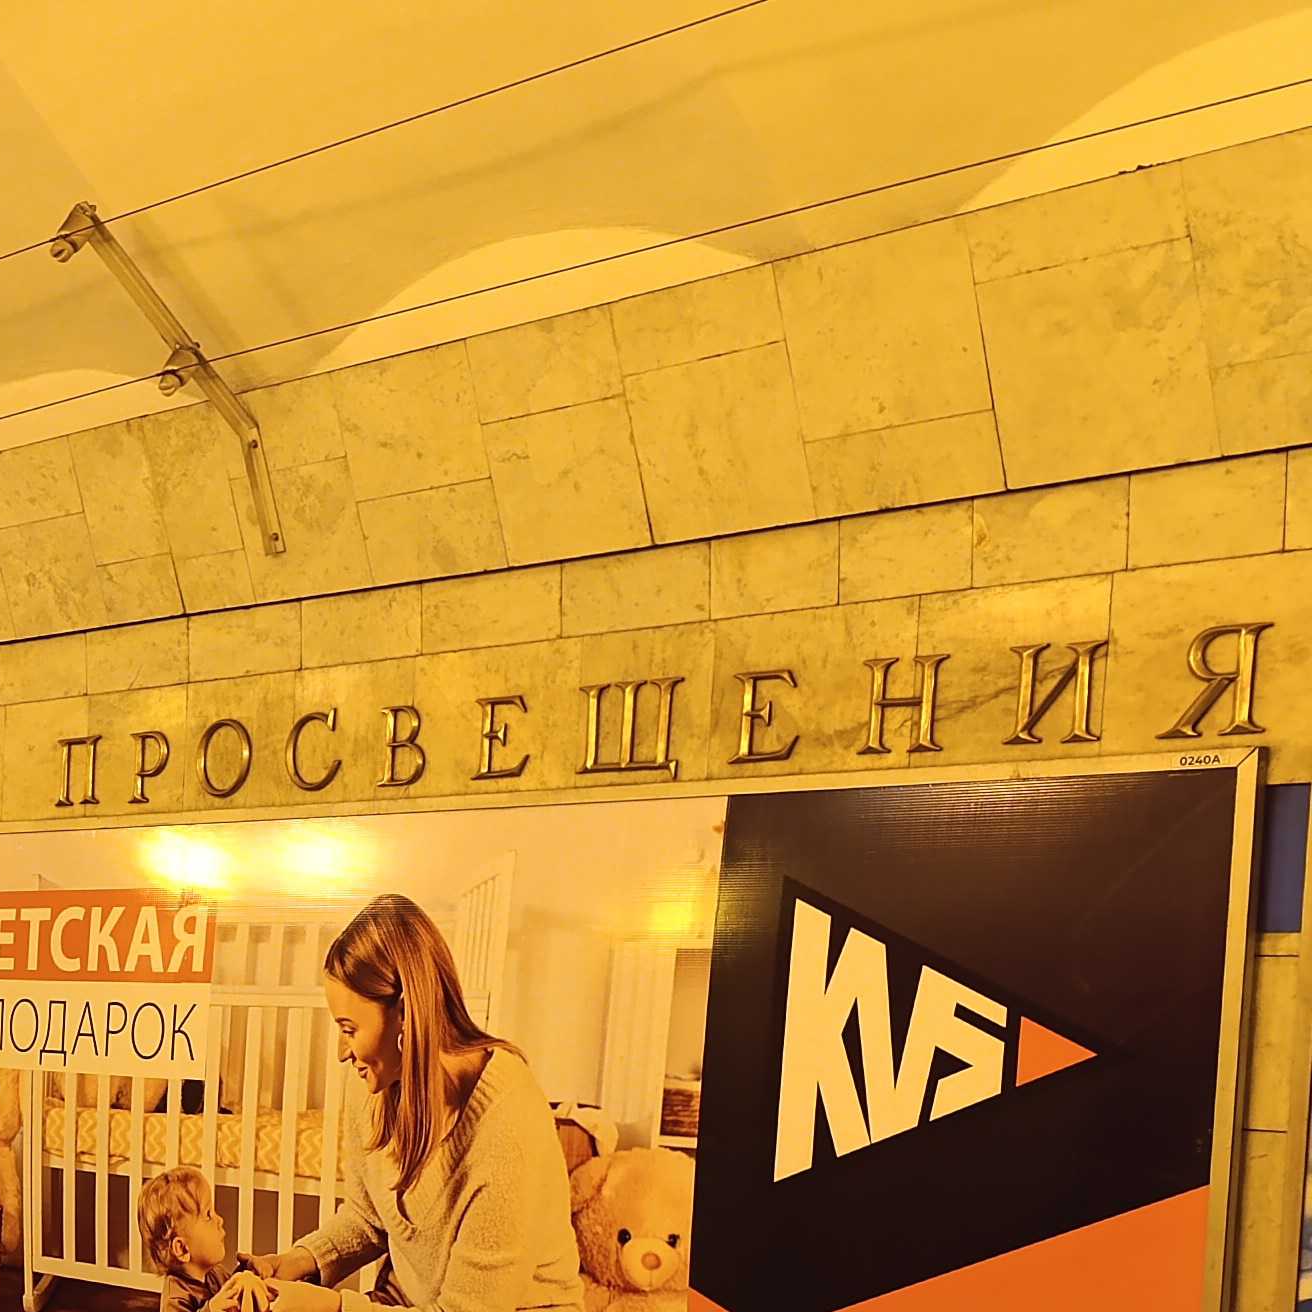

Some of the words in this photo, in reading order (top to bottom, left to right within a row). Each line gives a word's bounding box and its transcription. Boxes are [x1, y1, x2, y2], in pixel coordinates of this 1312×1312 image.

[56, 621, 1277, 807] ПРОСВЕЩЕНИЯ
[1179, 754, 1221, 766] 0240A
[774, 898, 1007, 1182] KVS
